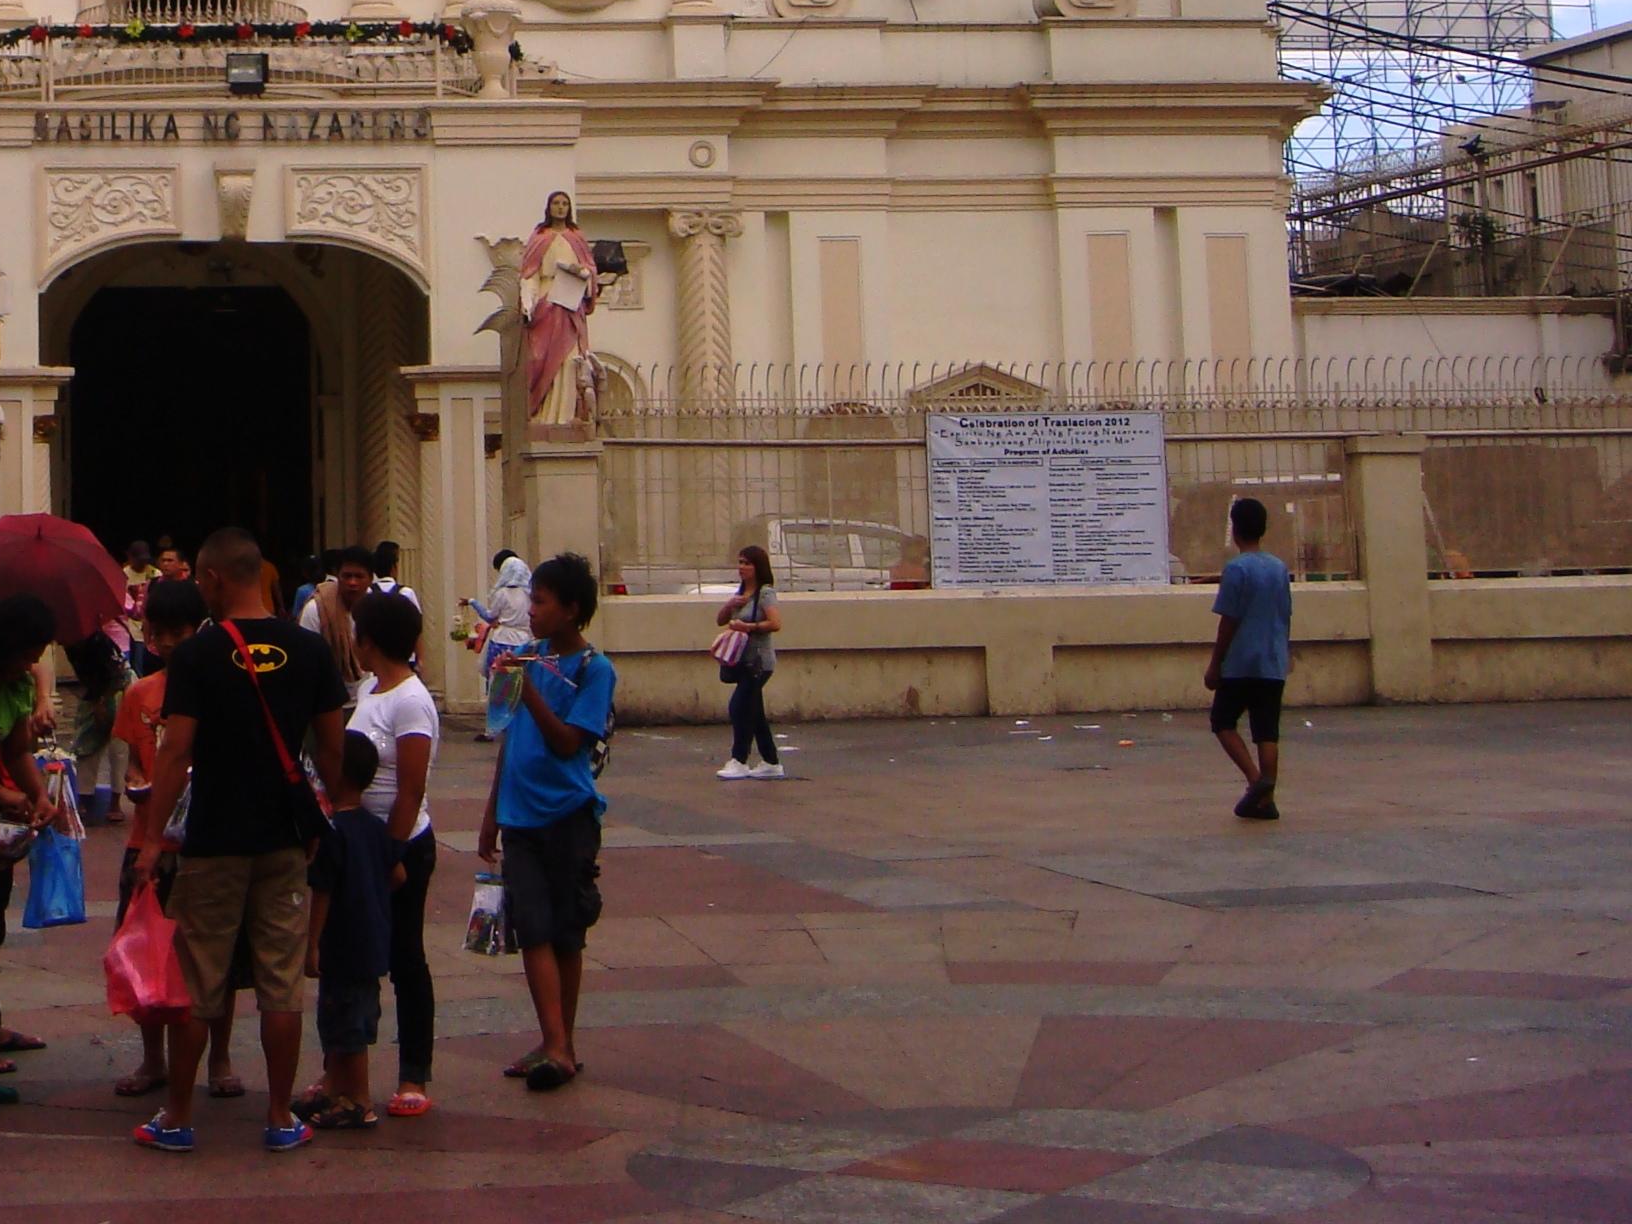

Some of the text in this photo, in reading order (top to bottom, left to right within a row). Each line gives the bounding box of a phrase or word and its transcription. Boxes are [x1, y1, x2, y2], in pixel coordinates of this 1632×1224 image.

[959, 416, 1131, 428] Celebration of Traslacion 2012
[1003, 448, 1040, 456] Program
[1052, 447, 1089, 455] Activities
